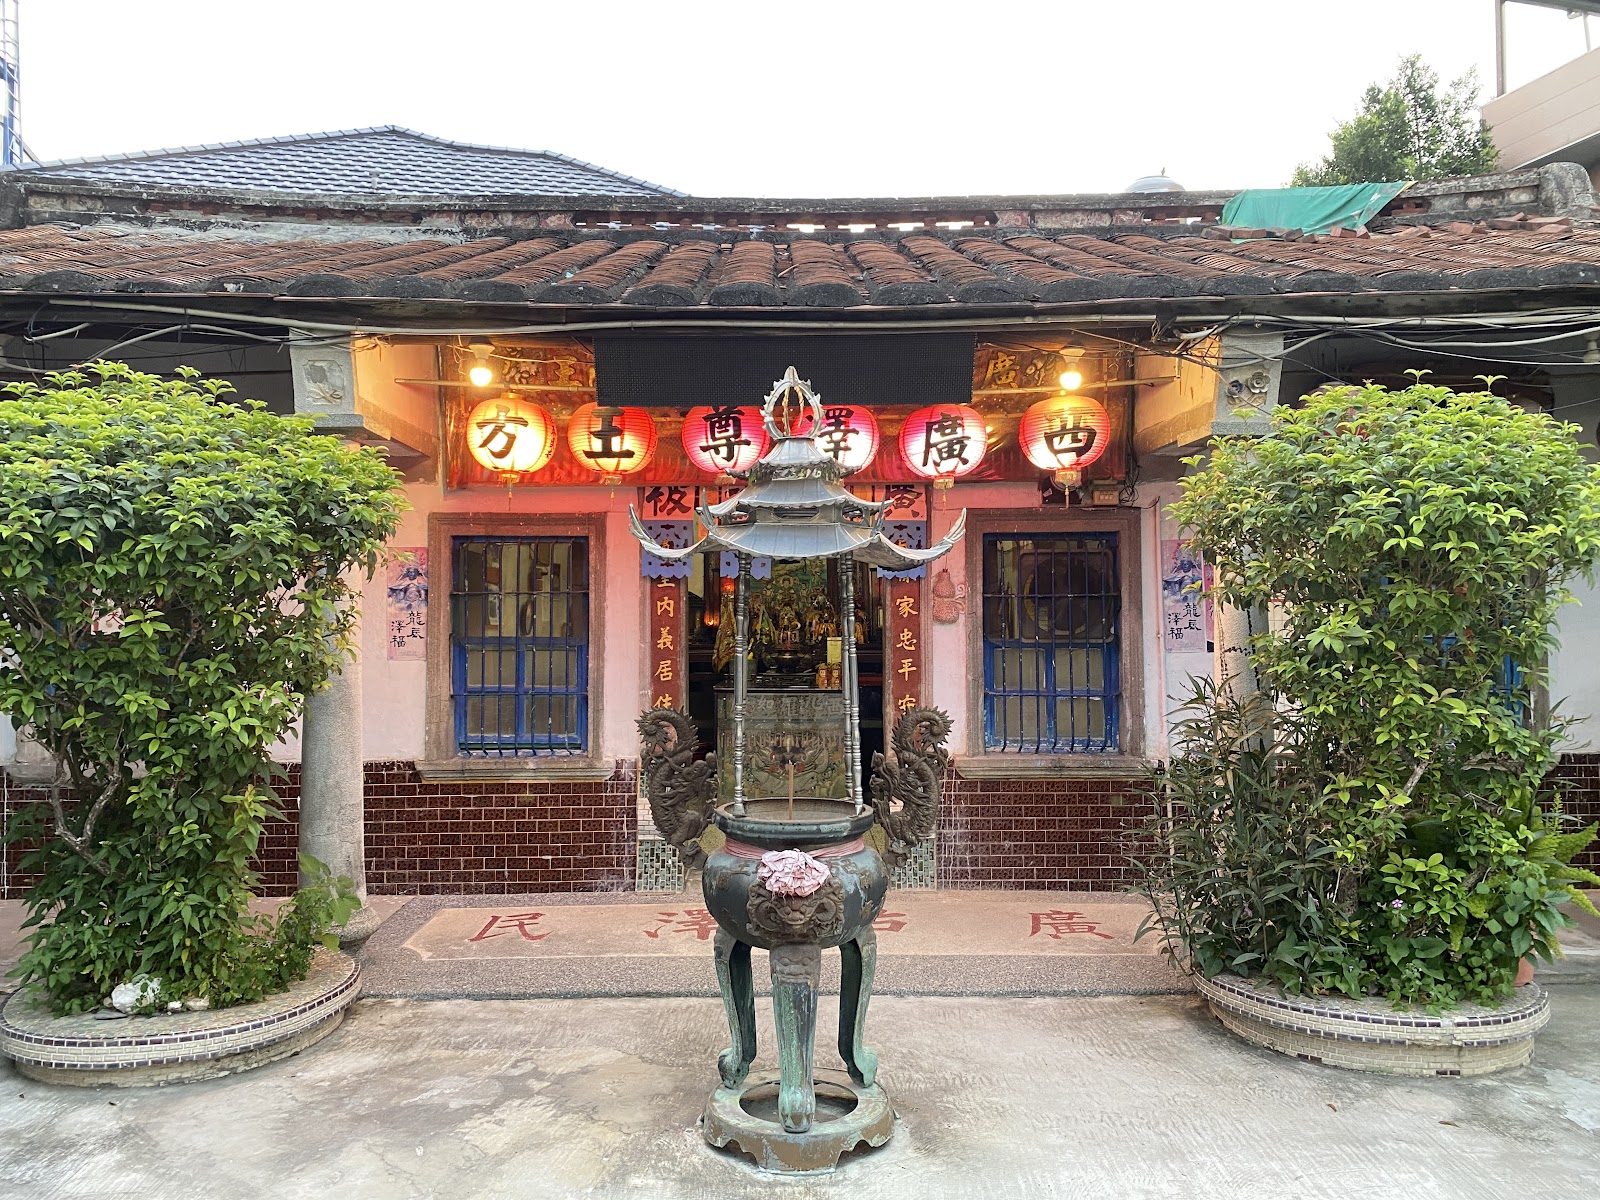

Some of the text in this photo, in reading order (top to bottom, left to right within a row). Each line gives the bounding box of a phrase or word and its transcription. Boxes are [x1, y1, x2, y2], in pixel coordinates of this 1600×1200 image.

[477, 404, 528, 459] 方
[583, 406, 635, 459] 王
[699, 405, 751, 461] 尊
[922, 412, 972, 467] 廣
[1044, 410, 1096, 458] 西
